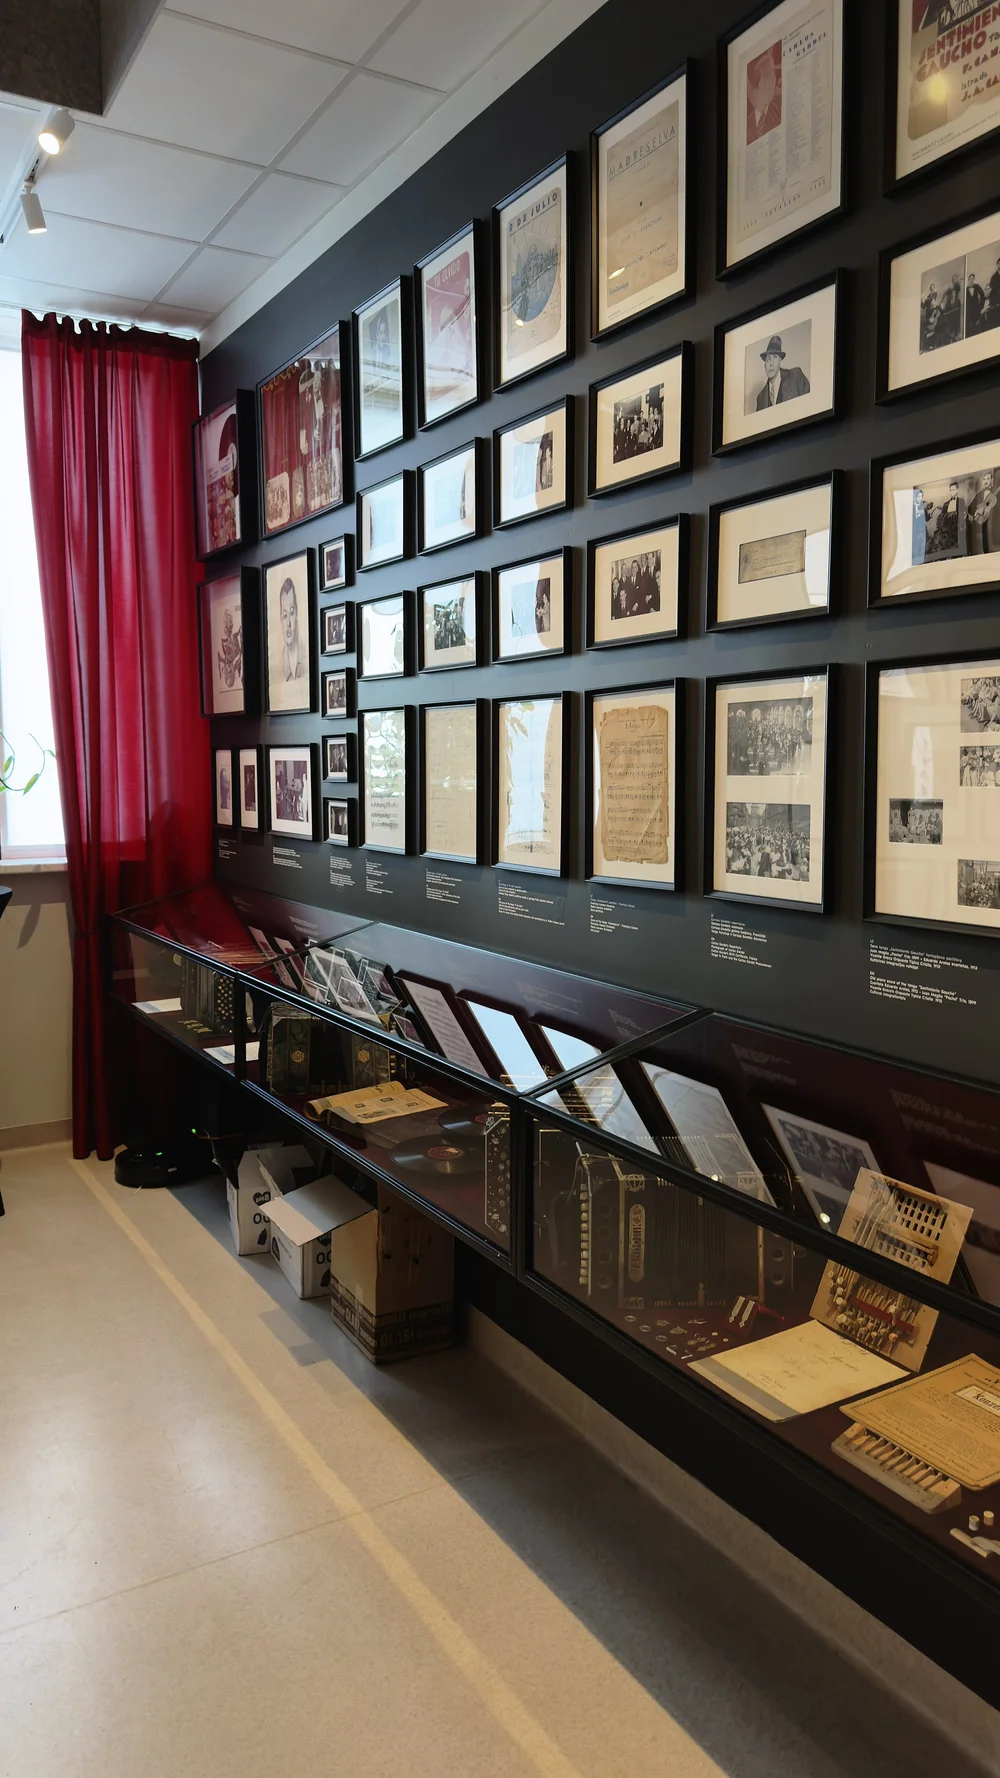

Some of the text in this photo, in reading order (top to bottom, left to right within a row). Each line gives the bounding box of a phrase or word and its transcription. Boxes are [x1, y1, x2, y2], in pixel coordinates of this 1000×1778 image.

[917, 31, 988, 82] GAUCHO
[974, 45, 1000, 67] CAN
[608, 124, 676, 179] MADRESELVA
[530, 191, 558, 218] JULIO
